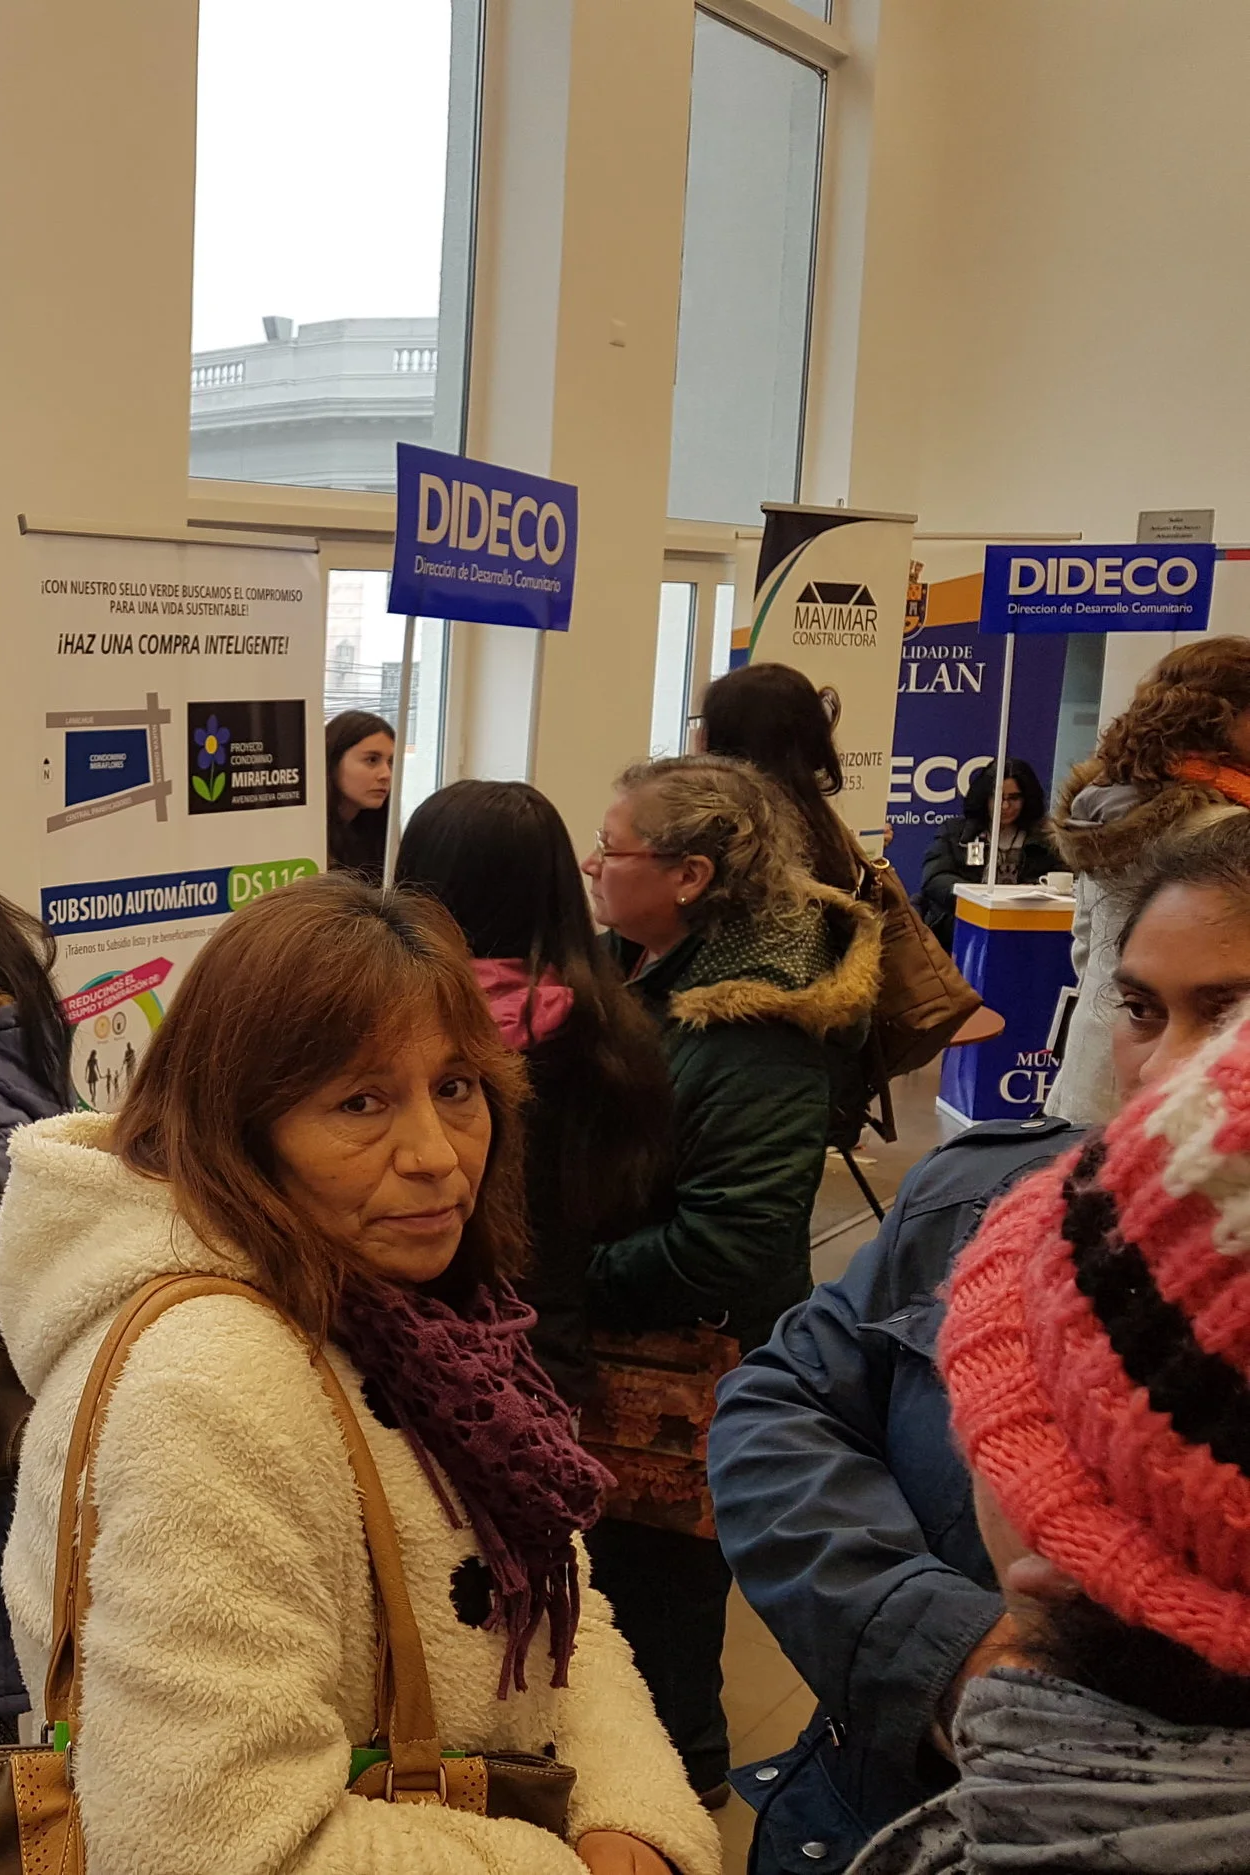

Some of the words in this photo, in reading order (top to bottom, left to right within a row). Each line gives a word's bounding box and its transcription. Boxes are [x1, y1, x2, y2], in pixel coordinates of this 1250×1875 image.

[416, 472, 566, 565] DIDECO
[458, 562, 469, 580] de
[470, 564, 512, 586] Desarrollo
[514, 570, 561, 593] Comunitario
[1008, 557, 1198, 595] DIDECO
[41, 580, 68, 594] ¡CON
[70, 580, 117, 595] NUESTRO
[119, 582, 147, 596] SELLO
[150, 583, 179, 597] VERDE
[182, 585, 231, 599] BUSCAMOS
[234, 587, 244, 600] EL
[246, 588, 303, 602] COMPROMISO
[110, 600, 135, 614] PARA
[138, 600, 159, 614] UNA
[161, 601, 184, 615] VIDA
[186, 602, 249, 616] SUSTENTABLE!
[794, 606, 877, 632] MAVIMAR
[1060, 602, 1072, 614] de
[1075, 602, 1129, 614] Desarrollo
[1131, 602, 1193, 614] Comunitario
[57, 633, 96, 655] ¡HAZ
[101, 633, 134, 655] UNA
[138, 634, 200, 655] COMPRA
[205, 634, 289, 655] INTELIGENTE!
[792, 631, 877, 648] CONSTRUCTORA
[952, 646, 972, 659] DE
[898, 662, 986, 693] LAN
[232, 768, 299, 788] MIRAFLORES
[233, 871, 263, 902] DS
[48, 893, 123, 925] SUBSIDIO
[125, 880, 218, 915] AUTOMÁTICO
[98, 943, 105, 952] tu
[106, 936, 131, 951] Subsidio
[69, 978, 124, 1010] REDUCIMOS
[125, 974, 136, 986] EL
